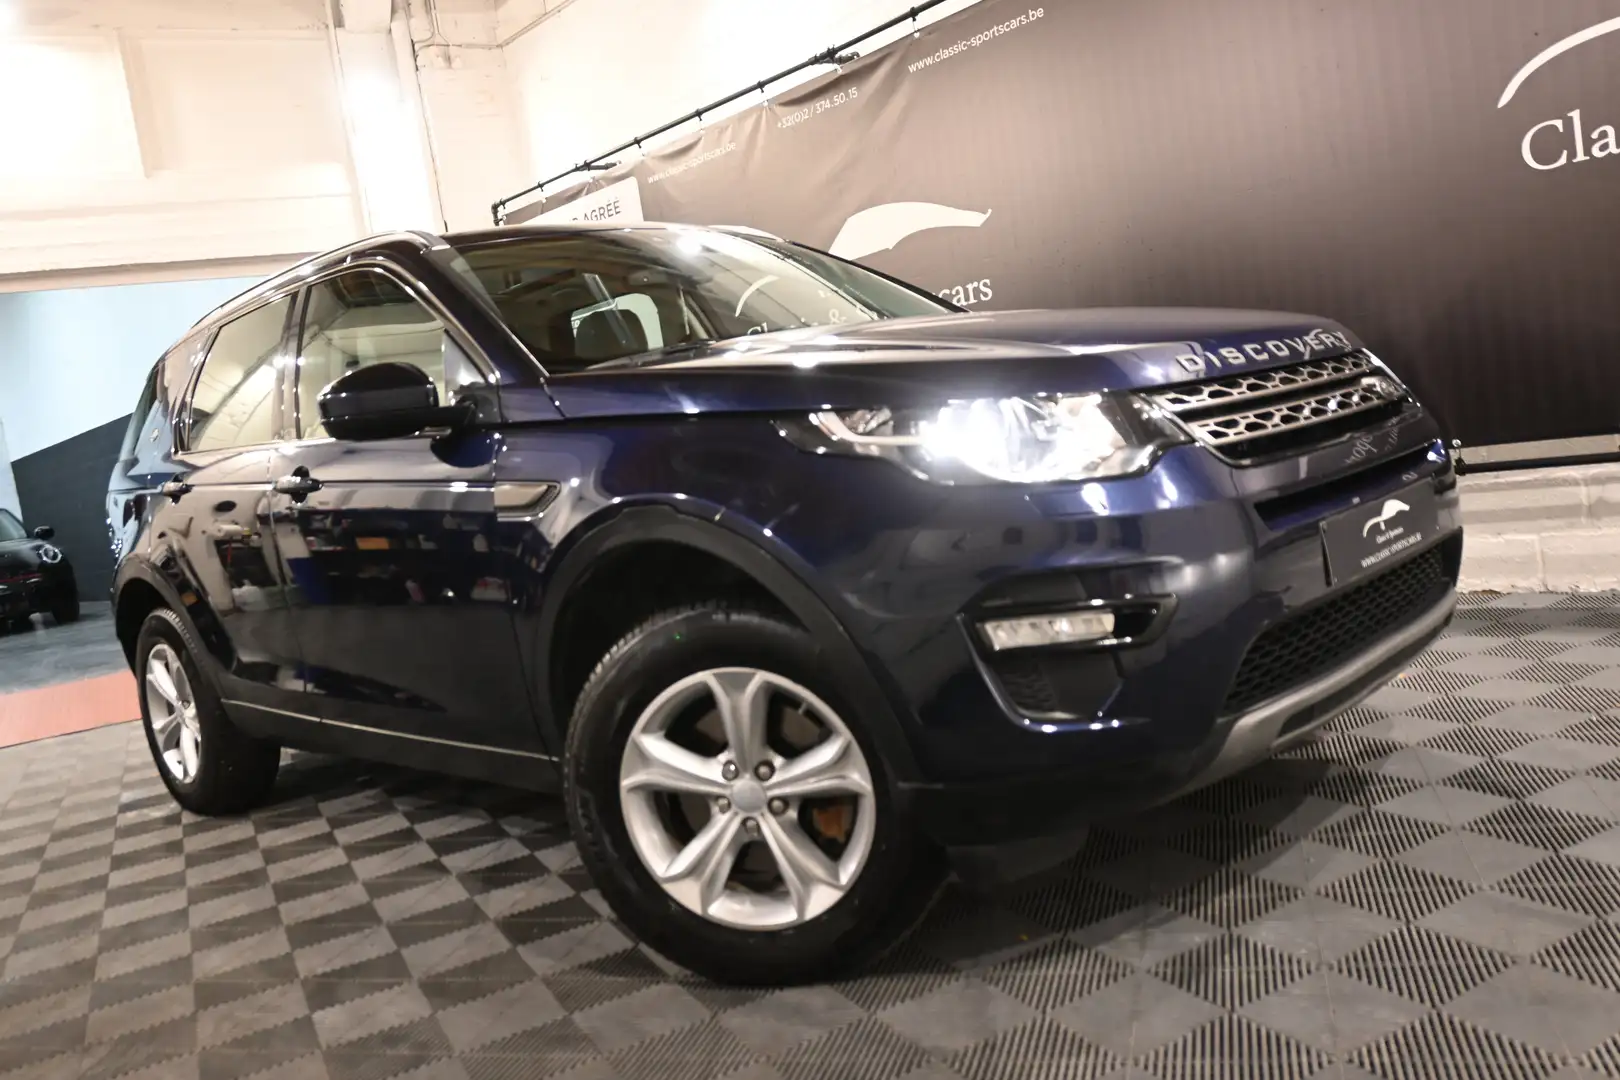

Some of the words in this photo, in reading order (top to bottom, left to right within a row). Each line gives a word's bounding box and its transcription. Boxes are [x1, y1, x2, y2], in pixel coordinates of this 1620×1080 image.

[907, 7, 1045, 74] www.classic-sportscars.be
[777, 108, 810, 129] +32(0)2
[815, 86, 858, 114] 374.50.15
[1521, 108, 1620, 170] Cla
[1175, 330, 1352, 374] DISCOVERY
